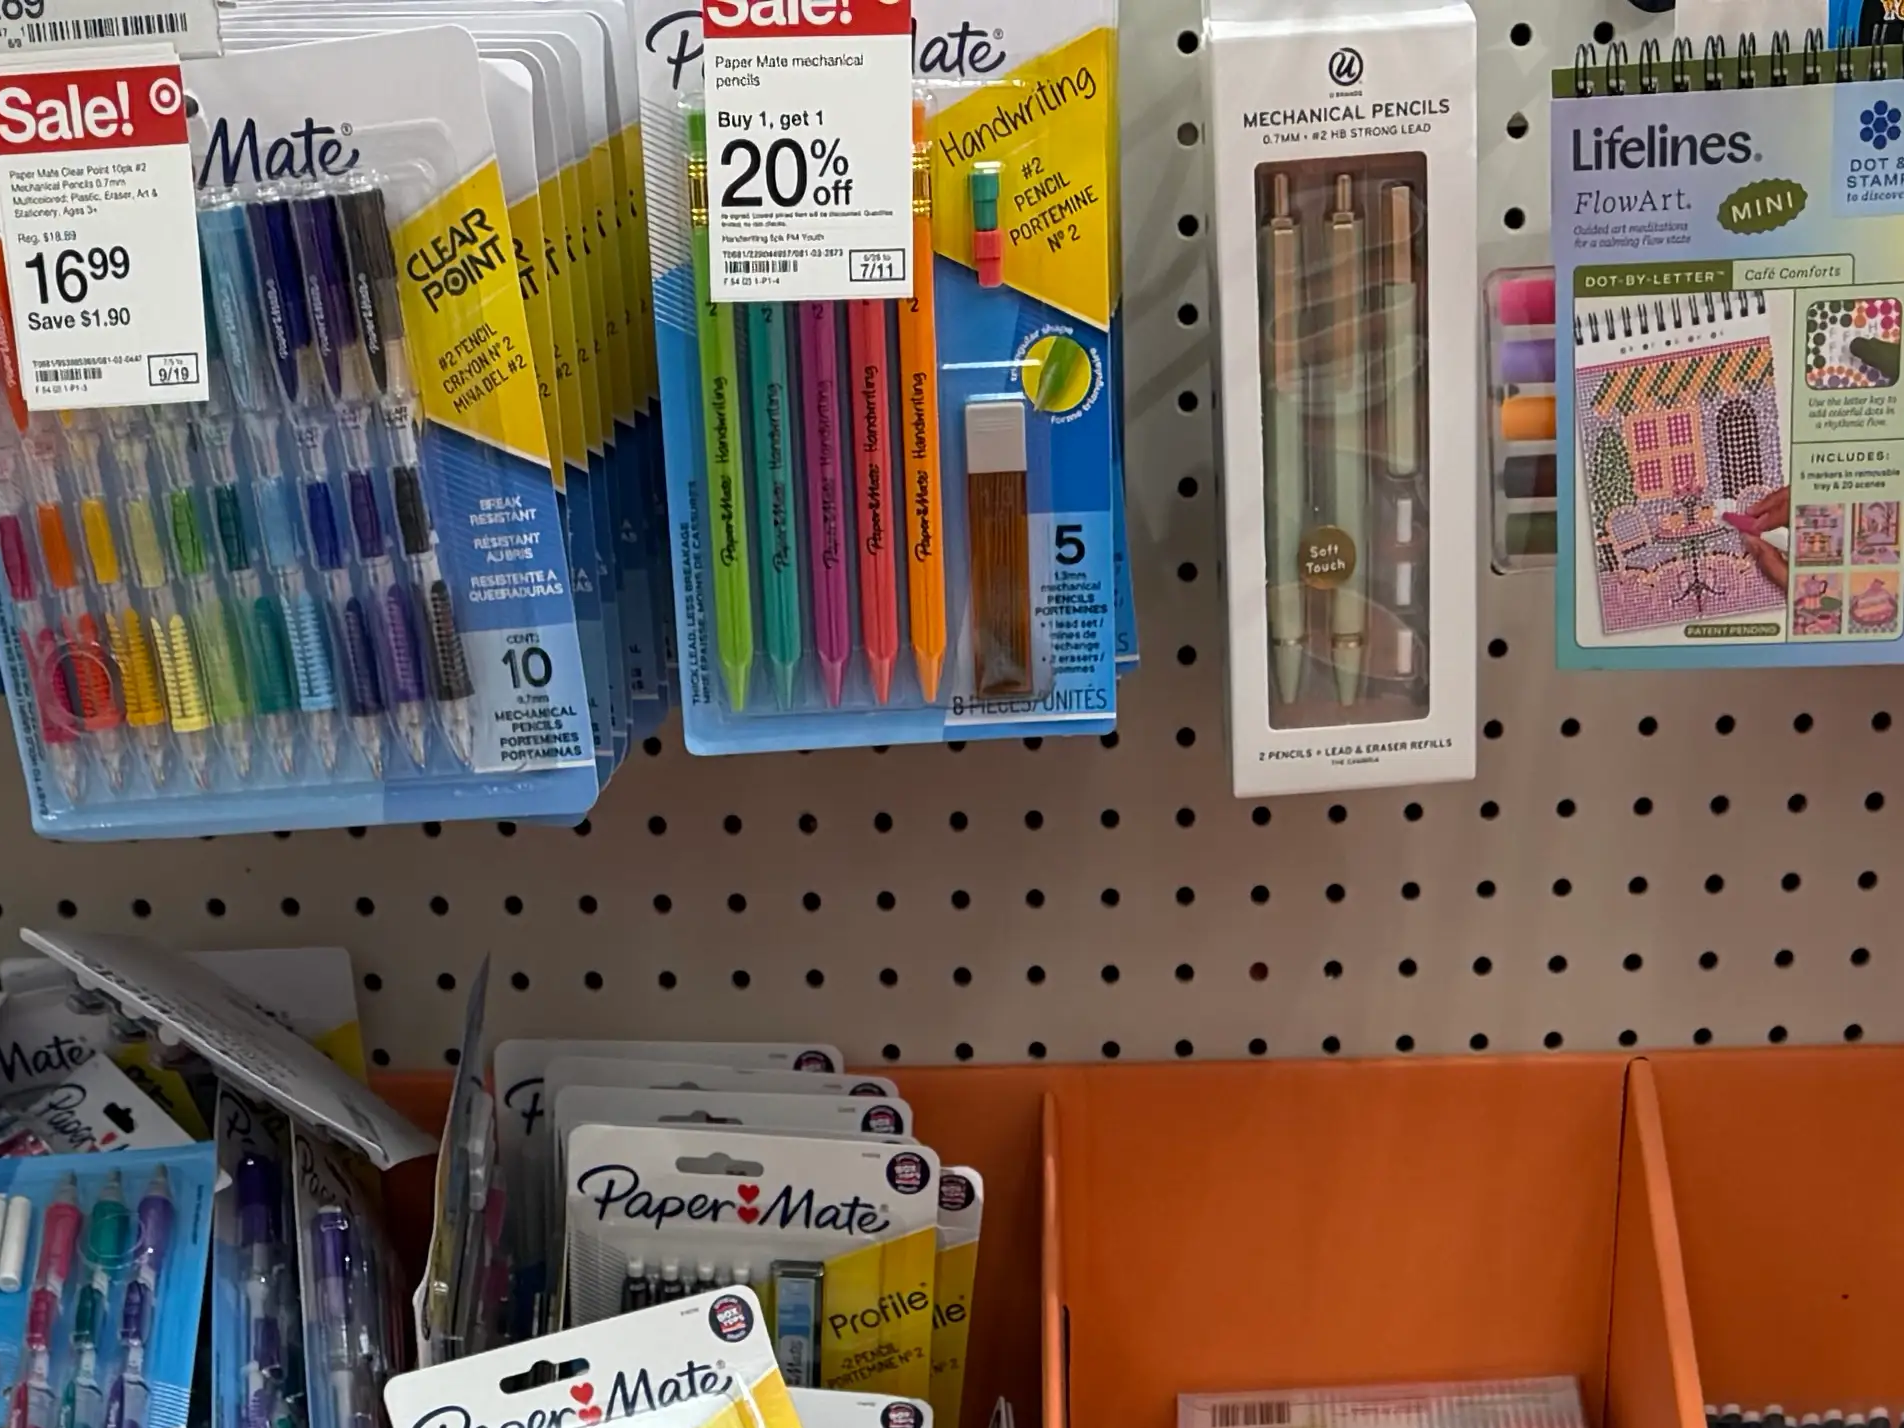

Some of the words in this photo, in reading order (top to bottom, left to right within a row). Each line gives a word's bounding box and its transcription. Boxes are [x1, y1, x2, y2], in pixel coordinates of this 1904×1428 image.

[940, 67, 1097, 168] Handwriting
[1243, 104, 1366, 129] MECHANICAL
[1371, 98, 1450, 119] PENCILS
[1350, 124, 1399, 139] STRONG
[1400, 122, 1432, 135] LEAD
[196, 117, 360, 191] Mate
[1850, 157, 1890, 173] DOT
[1015, 173, 1069, 211] PENCIL
[1731, 190, 1793, 224] MINI
[1846, 192, 1859, 203] to
[1010, 186, 1099, 248] PORTEMINE
[1744, 267, 1776, 282] Café
[1779, 264, 1841, 280] Comforts
[27, 311, 76, 331] Save
[80, 306, 131, 328] $1.90
[158, 367, 190, 383] 9/19
[1055, 523, 1086, 566] 5
[1309, 543, 1339, 559] Soft
[1305, 558, 1346, 574] Touch
[501, 646, 553, 689] 10
[576, 1164, 737, 1231] Paper
[757, 1184, 891, 1236] Mate
